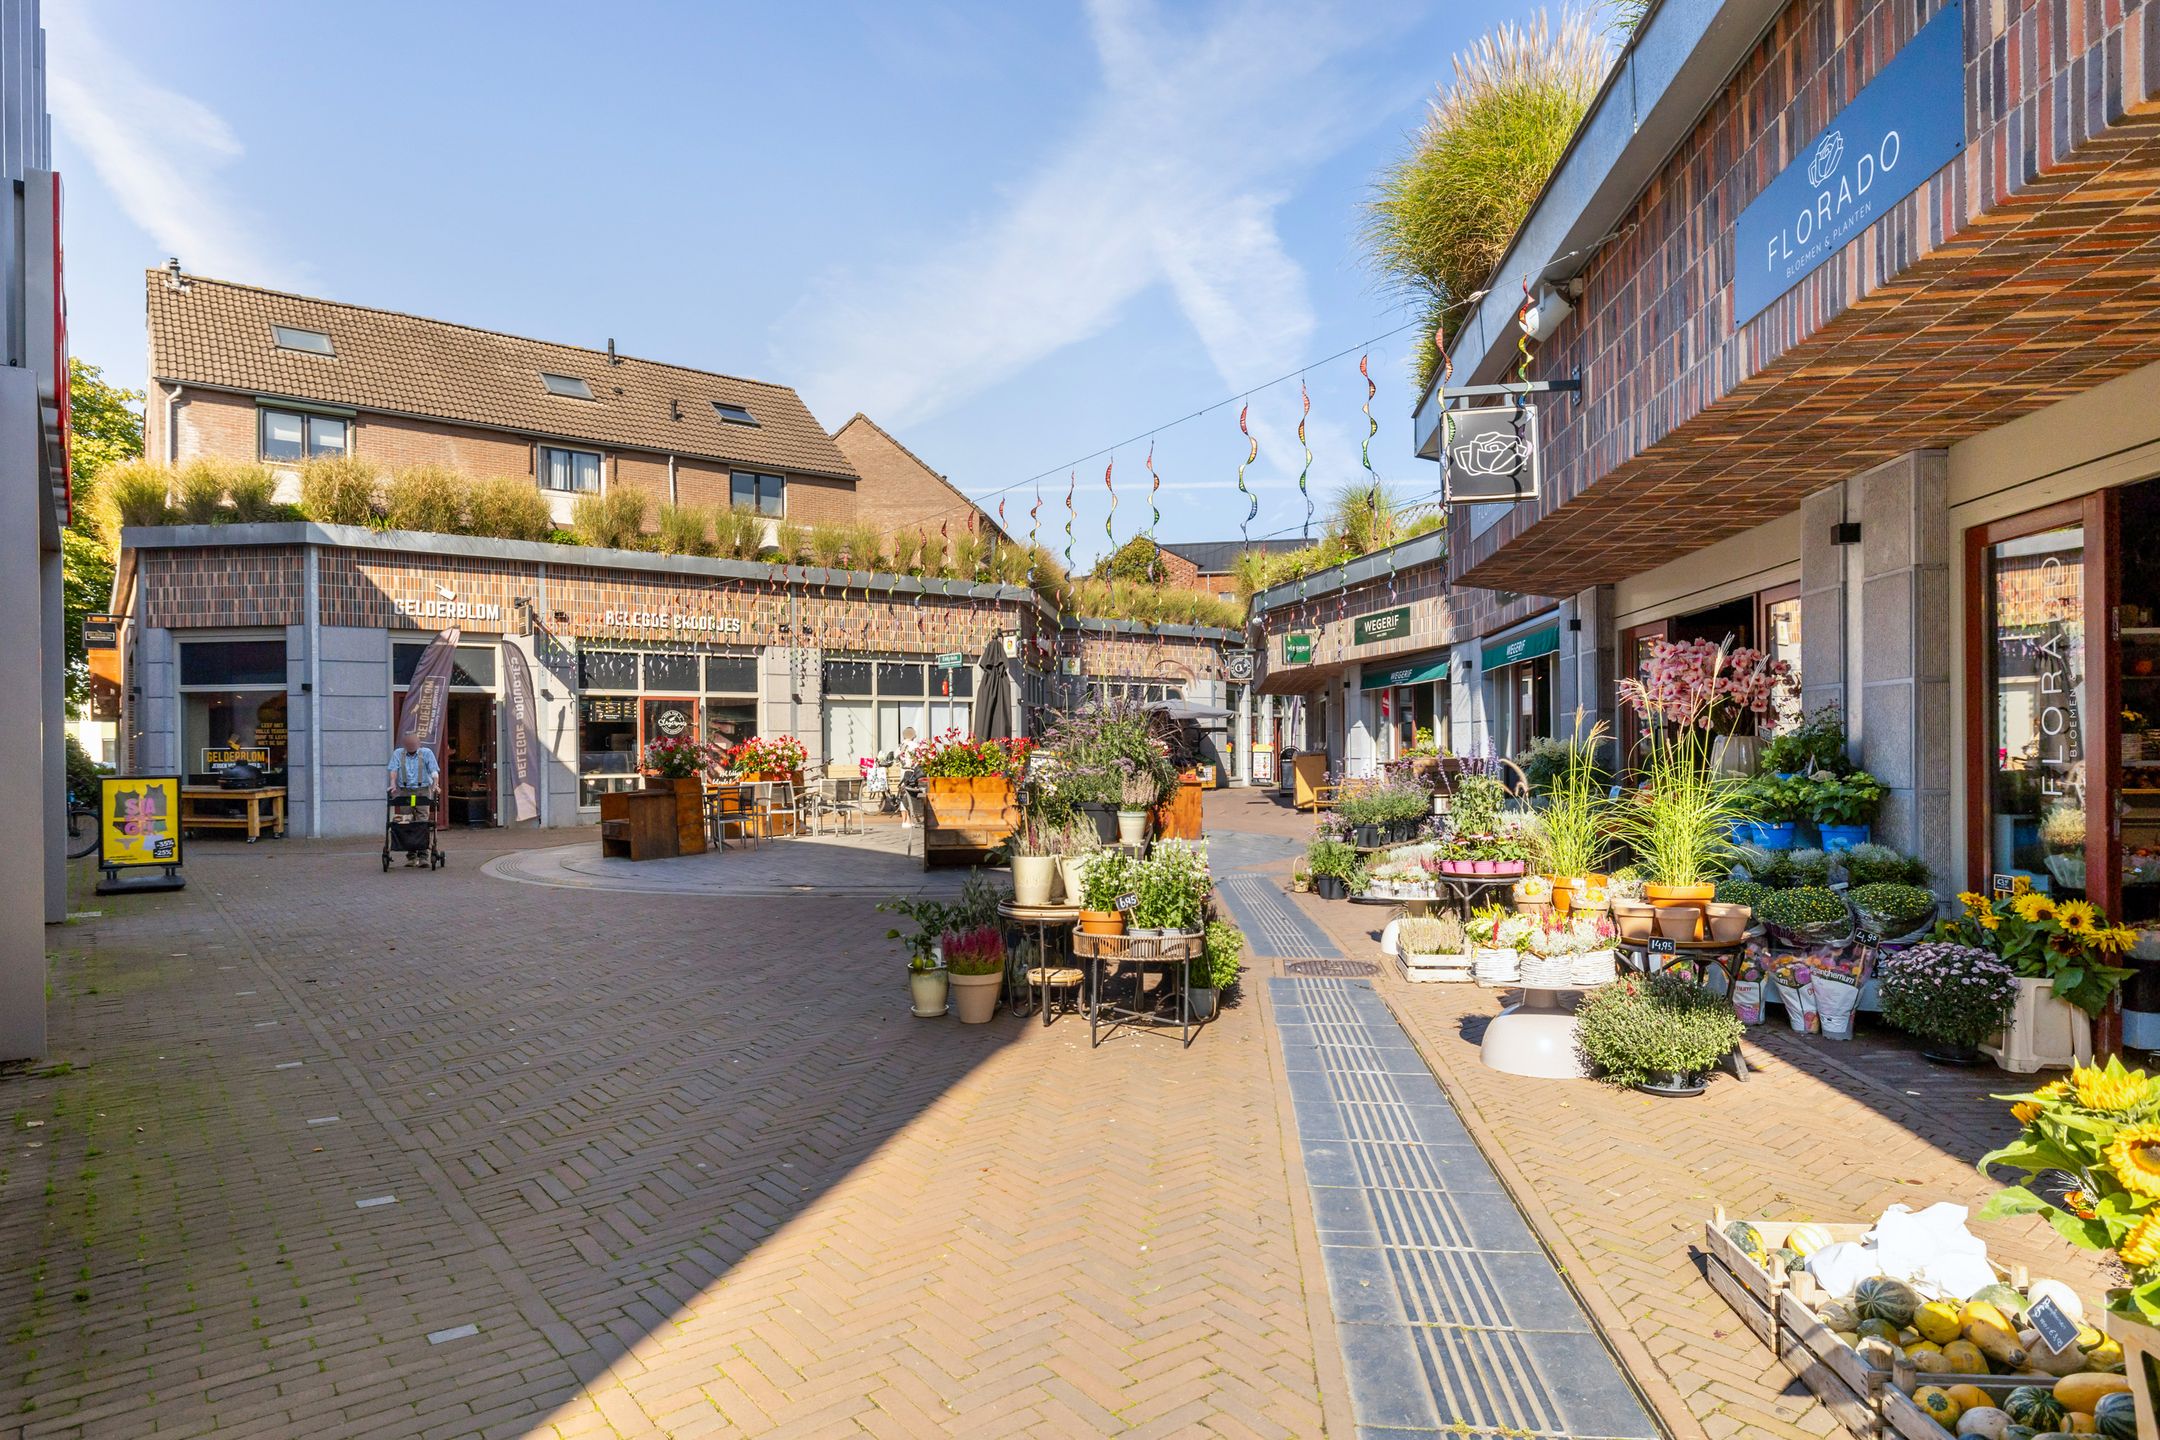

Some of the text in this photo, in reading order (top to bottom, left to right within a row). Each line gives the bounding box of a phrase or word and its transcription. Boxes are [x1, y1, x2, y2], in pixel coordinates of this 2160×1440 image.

[1768, 130, 1900, 272] FLORADO
[1786, 200, 1872, 279] BLOEMEN & PLANTEN
[394, 598, 500, 621] GELDERBLOM
[605, 610, 669, 628] BELEGDE
[1364, 614, 1400, 633] WEGERIF
[416, 680, 435, 738] GELDERBLOM
[2069, 688, 2078, 758] BLOEMEN
[1651, 939, 1673, 951] 14,95
